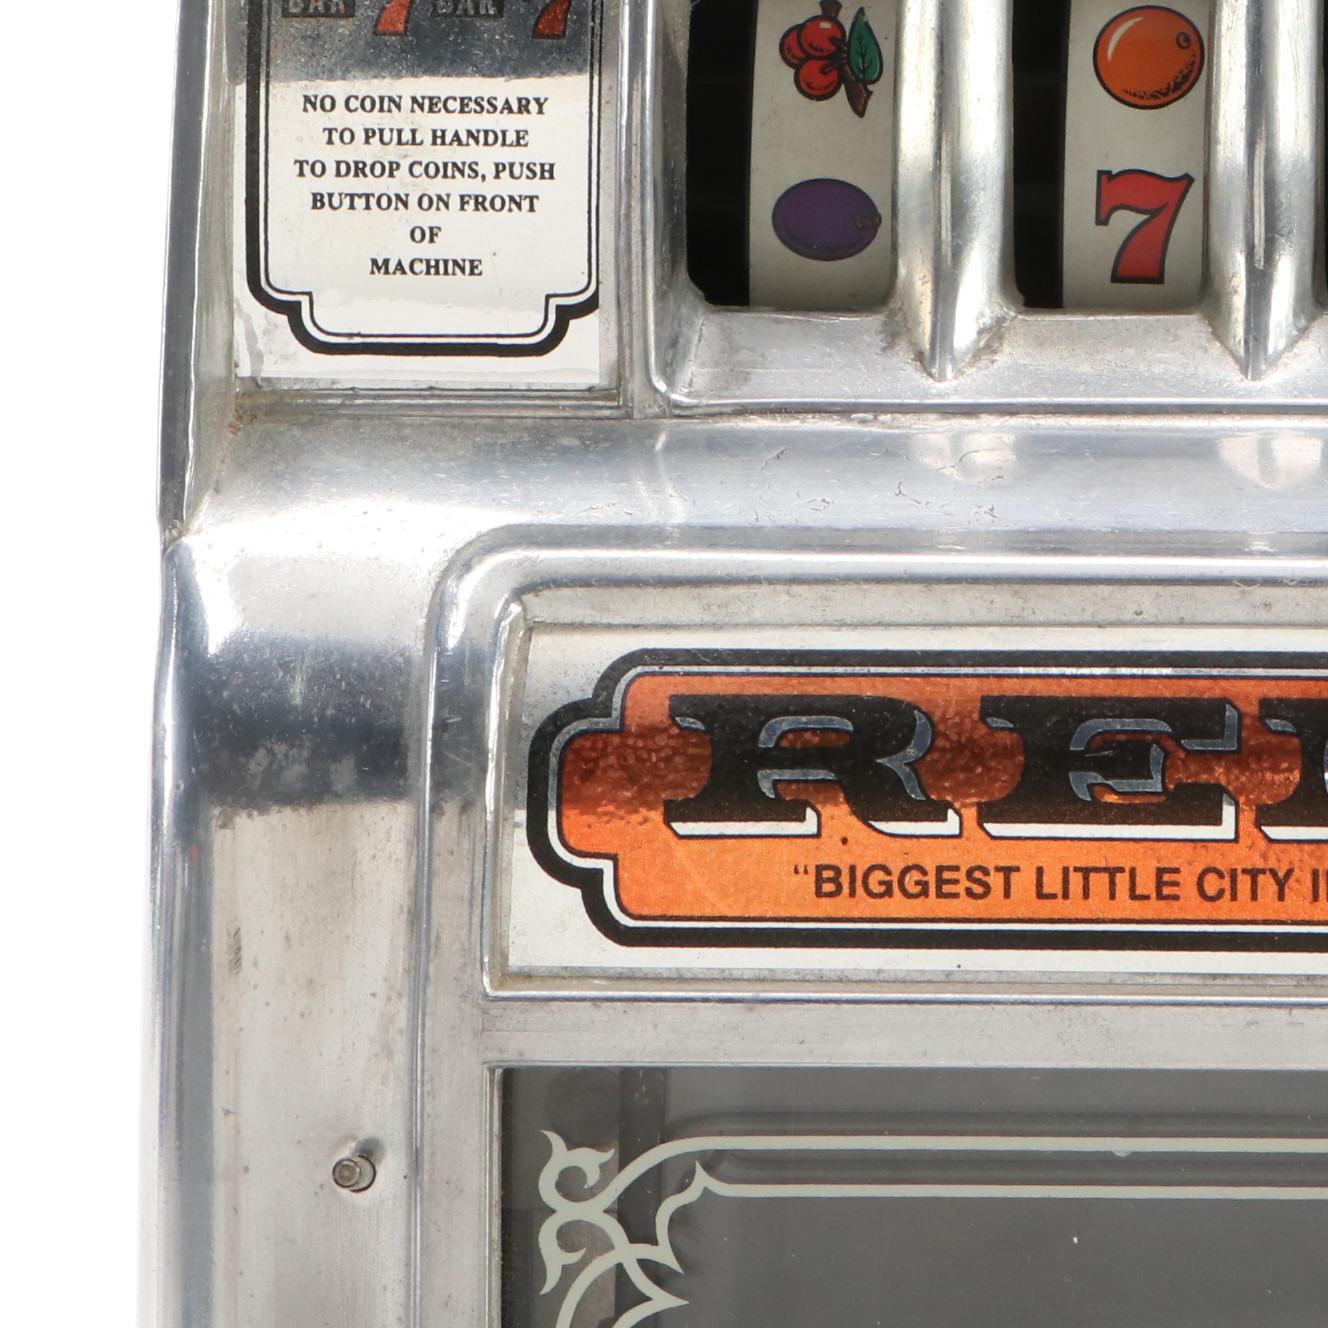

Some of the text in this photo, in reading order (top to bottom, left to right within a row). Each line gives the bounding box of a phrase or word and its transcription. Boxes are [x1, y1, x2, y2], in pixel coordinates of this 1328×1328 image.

[302, 95, 549, 115] NO COIN NECESSARY
[323, 127, 529, 147] TO PULL HANDLE
[294, 159, 555, 182] TO DROP COINS, PUSH
[311, 192, 540, 212] BUTTON ON FRONT
[409, 226, 442, 243] OF
[1095, 169, 1195, 284] 7
[369, 258, 483, 276] MACHINE
[1035, 865, 1181, 901] LITTLE
[1196, 866, 1295, 902] CITY
